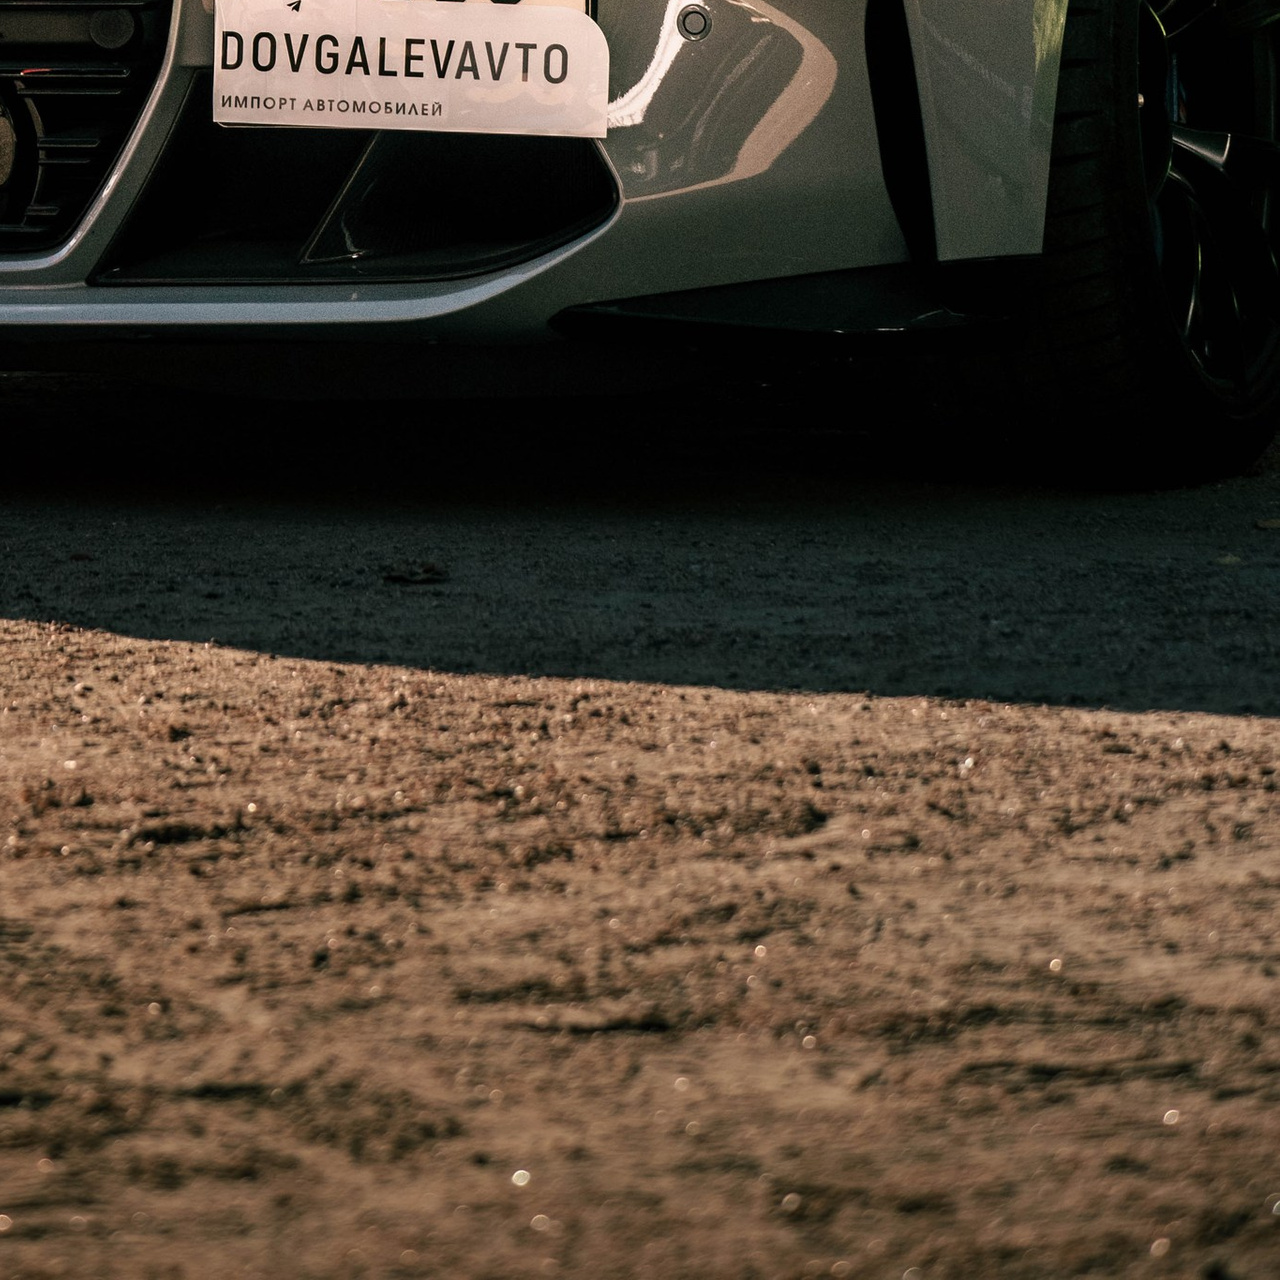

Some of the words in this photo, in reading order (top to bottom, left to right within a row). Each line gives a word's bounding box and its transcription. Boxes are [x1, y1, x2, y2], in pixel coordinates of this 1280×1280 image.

[220, 31, 568, 85] DOVGALEVAVTO
[221, 95, 297, 111] ИМПОРТ
[302, 98, 443, 117] АВТОМОБИЛЕЙ
